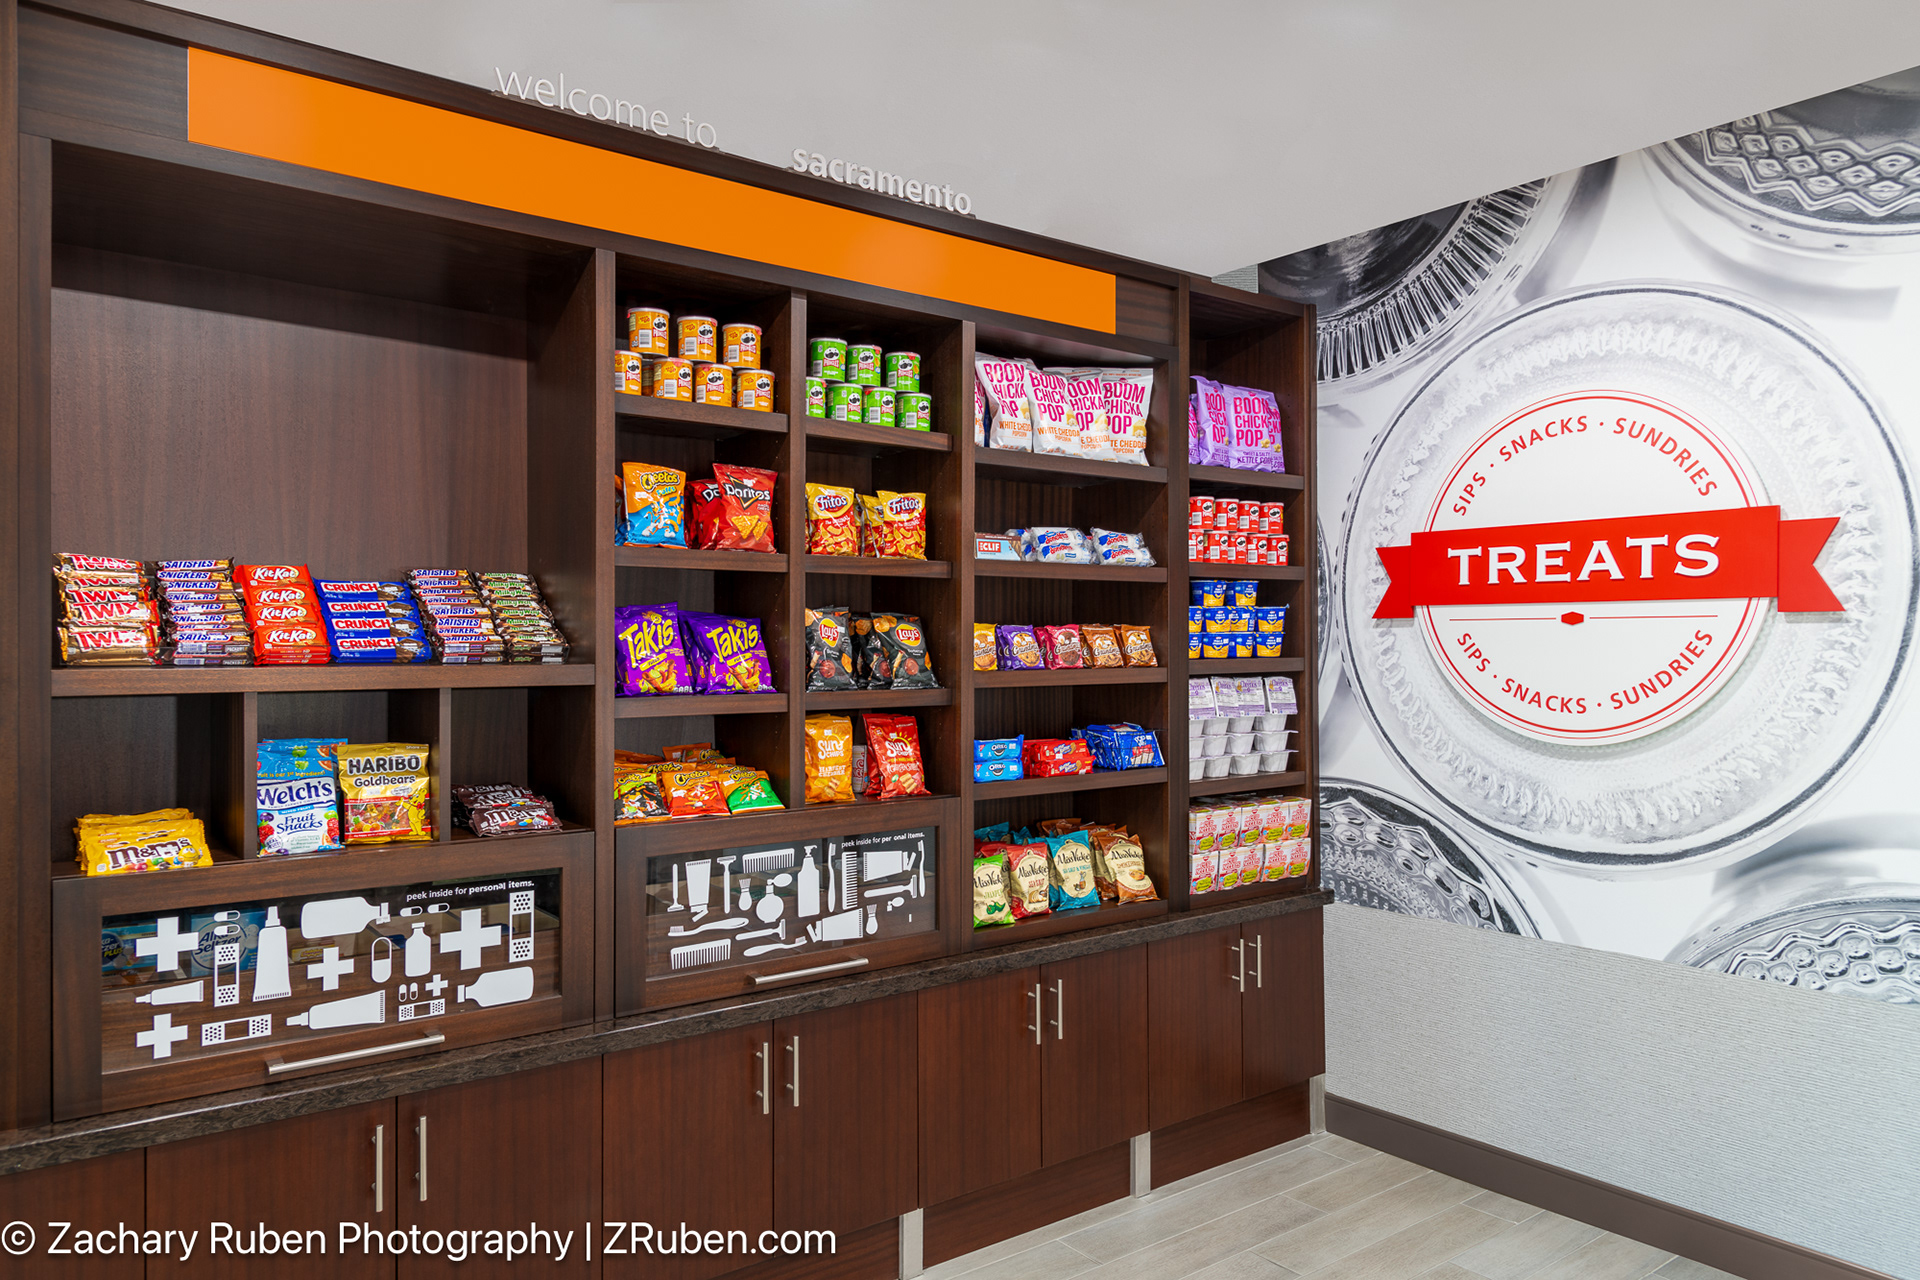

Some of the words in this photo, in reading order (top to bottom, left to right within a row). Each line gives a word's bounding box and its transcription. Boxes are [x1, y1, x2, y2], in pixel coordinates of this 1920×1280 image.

[495, 66, 669, 137] welcome
[681, 112, 717, 148] to
[792, 148, 971, 215] sacramento
[1067, 377, 1102, 398] OOM
[1103, 382, 1146, 404] BOOM
[1037, 402, 1065, 422] POP
[1069, 396, 1106, 411] HICKA
[1236, 429, 1263, 447] POP
[1453, 471, 1487, 516] SIPS
[1499, 415, 1588, 462] SNACKS
[1612, 417, 1718, 497] SUNDRIES
[641, 471, 679, 492] Cheetos
[725, 483, 771, 500] Doritos
[816, 495, 848, 511] Fritos
[887, 497, 920, 515] Fritos
[983, 543, 1000, 551] CLIF
[1447, 533, 1720, 586] TREATS
[323, 583, 378, 592] CRUNCH
[73, 602, 139, 621] TWIX
[330, 602, 387, 612] CRUNCH
[335, 618, 391, 629] CRUNCH
[438, 618, 480, 627] SATISFIES
[821, 623, 838, 641] Lay's
[899, 628, 920, 641] Lay's
[339, 638, 397, 650] CRUNCH
[618, 619, 674, 669] Takis
[706, 624, 759, 663] Takis
[1457, 632, 1491, 673] SIPS
[1501, 678, 1588, 714] SNACKS
[1610, 629, 1714, 710] SUNDRIES
[818, 740, 844, 760] Sun
[885, 740, 913, 757] Sun
[348, 755, 420, 774] HARIBO
[354, 775, 416, 787] Goldbears
[257, 781, 333, 806] Welch's
[276, 820, 323, 835] Snacks
[285, 813, 316, 825] Fruit
[841, 840, 855, 849] peek
[855, 837, 872, 846] inside
[907, 831, 926, 839] items.
[1057, 853, 1073, 866] Miss
[1018, 865, 1032, 879] Miss
[406, 891, 428, 902] peek
[429, 889, 453, 898] inside
[455, 886, 468, 895] for
[468, 882, 506, 895] personal
[508, 880, 535, 889] items.
[103, 947, 123, 958] PLUS
